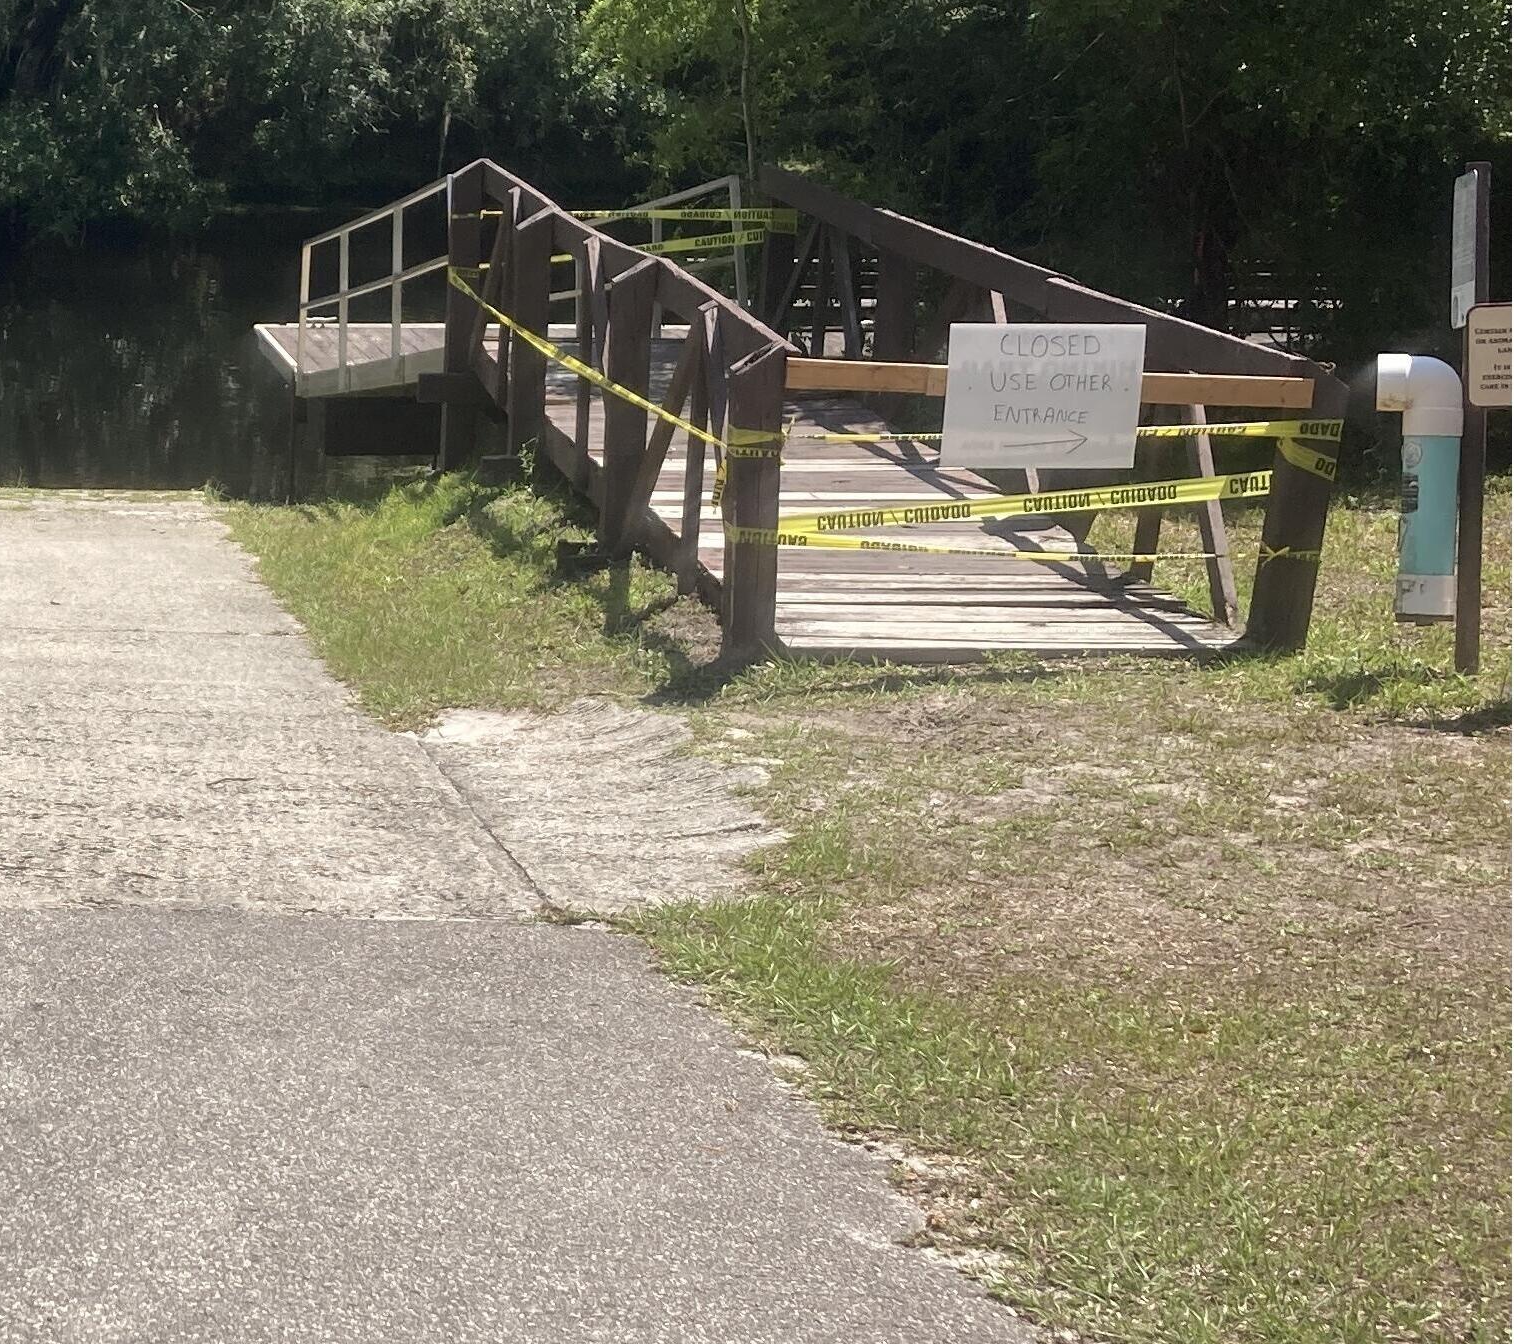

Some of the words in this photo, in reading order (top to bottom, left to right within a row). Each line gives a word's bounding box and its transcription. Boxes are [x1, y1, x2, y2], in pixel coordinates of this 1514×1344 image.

[694, 230, 736, 247] CAUTION
[999, 333, 1102, 358] CLOSED
[990, 370, 1037, 393] USE
[1049, 373, 1113, 392] OTHER
[993, 404, 1090, 425] ENTRANCE
